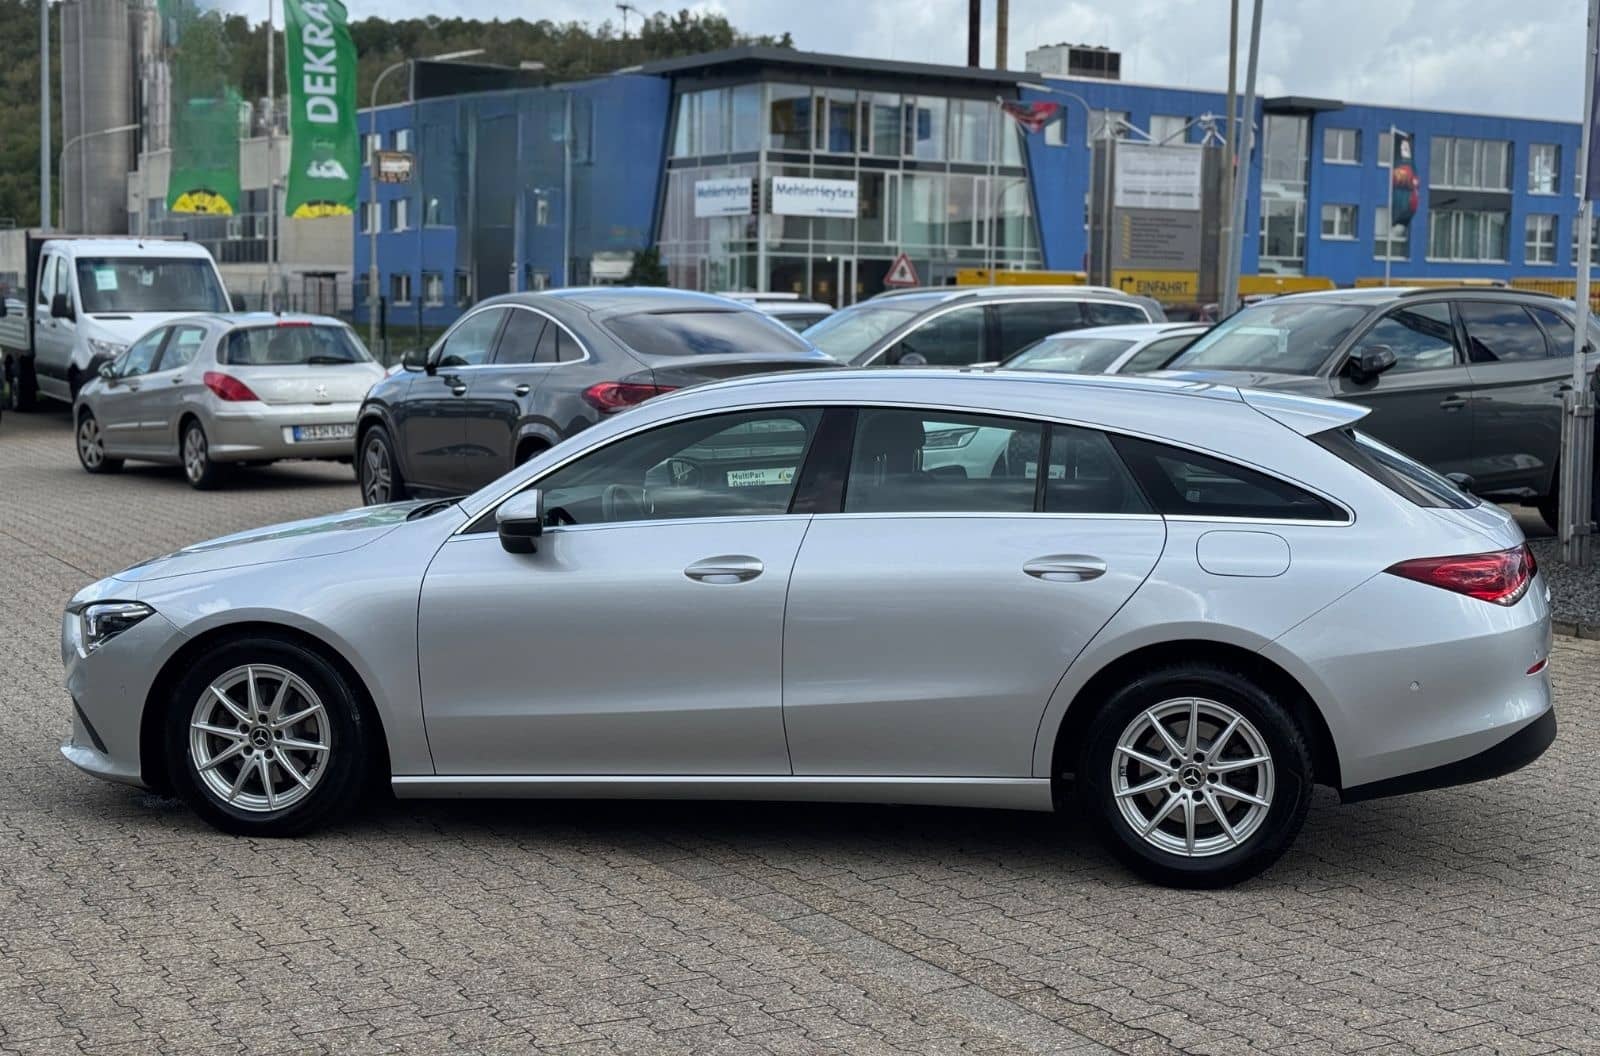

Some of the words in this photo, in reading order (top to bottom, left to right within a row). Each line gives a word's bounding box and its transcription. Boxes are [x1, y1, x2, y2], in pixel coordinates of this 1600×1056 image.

[303, 0, 338, 123] DEKRA
[776, 183, 854, 201] MehlerHeytex
[1136, 280, 1188, 296] EINFAHRT
